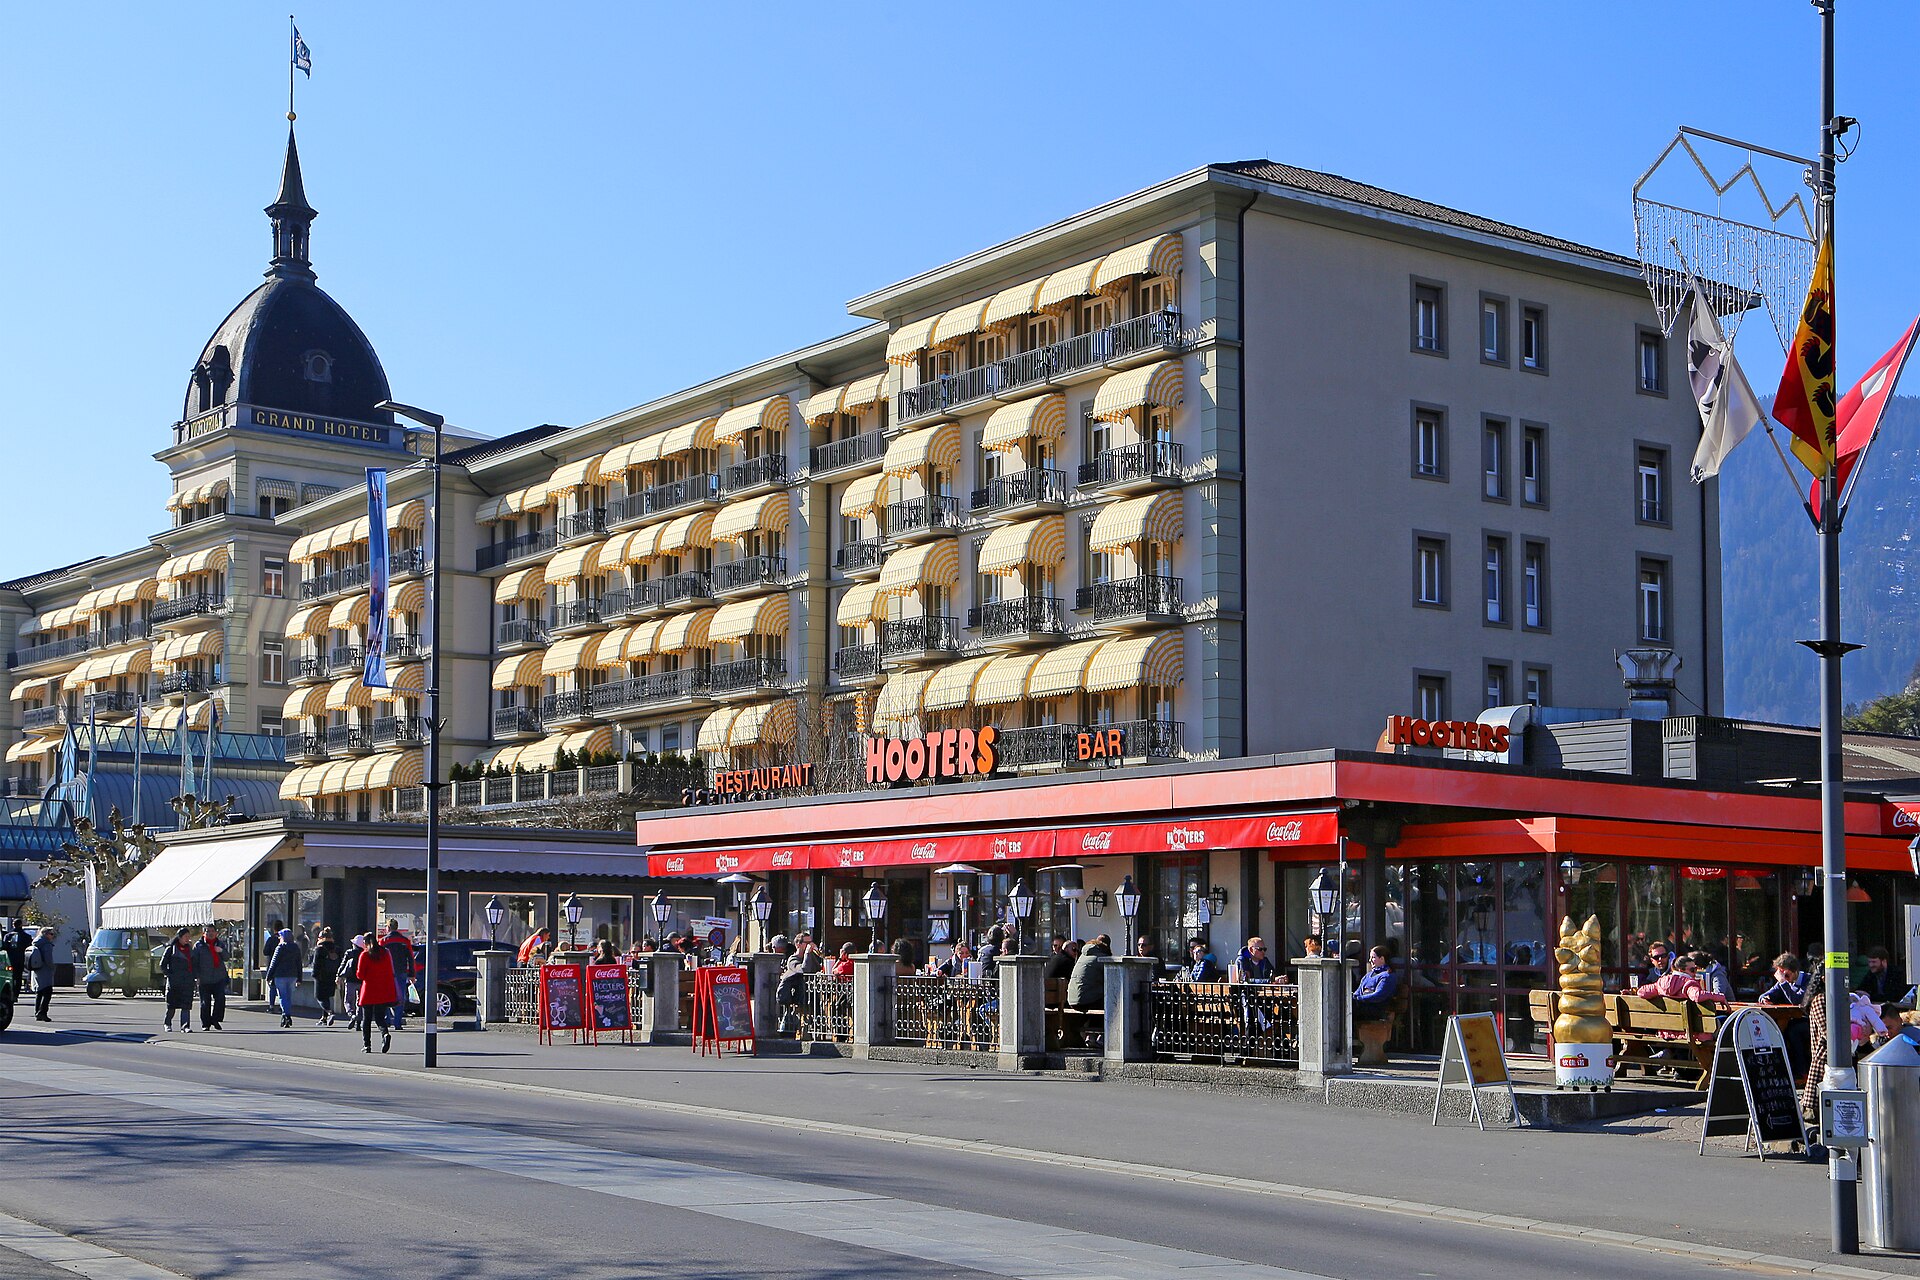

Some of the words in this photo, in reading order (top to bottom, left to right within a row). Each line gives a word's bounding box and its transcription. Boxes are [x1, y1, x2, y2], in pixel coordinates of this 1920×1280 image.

[255, 411, 316, 432] GRAND
[324, 421, 382, 442] HOTEL
[1392, 715, 1510, 753] HOOTERS
[1077, 729, 1122, 760] BAR
[866, 725, 996, 784] HOOTERS
[715, 763, 812, 795] RESTAURANT
[1166, 829, 1205, 846] HOOTERS
[1266, 820, 1303, 842] Coca-Cola
[1082, 831, 1113, 851] Coca-Cola
[911, 842, 938, 860] Coca-Cola
[549, 968, 574, 978] Coca-Cola
[594, 968, 620, 979] Coca-Cola
[715, 973, 741, 984] Coca-Cola
[592, 981, 626, 992] HOOTERS
[714, 986, 746, 1001] HOOTERS
